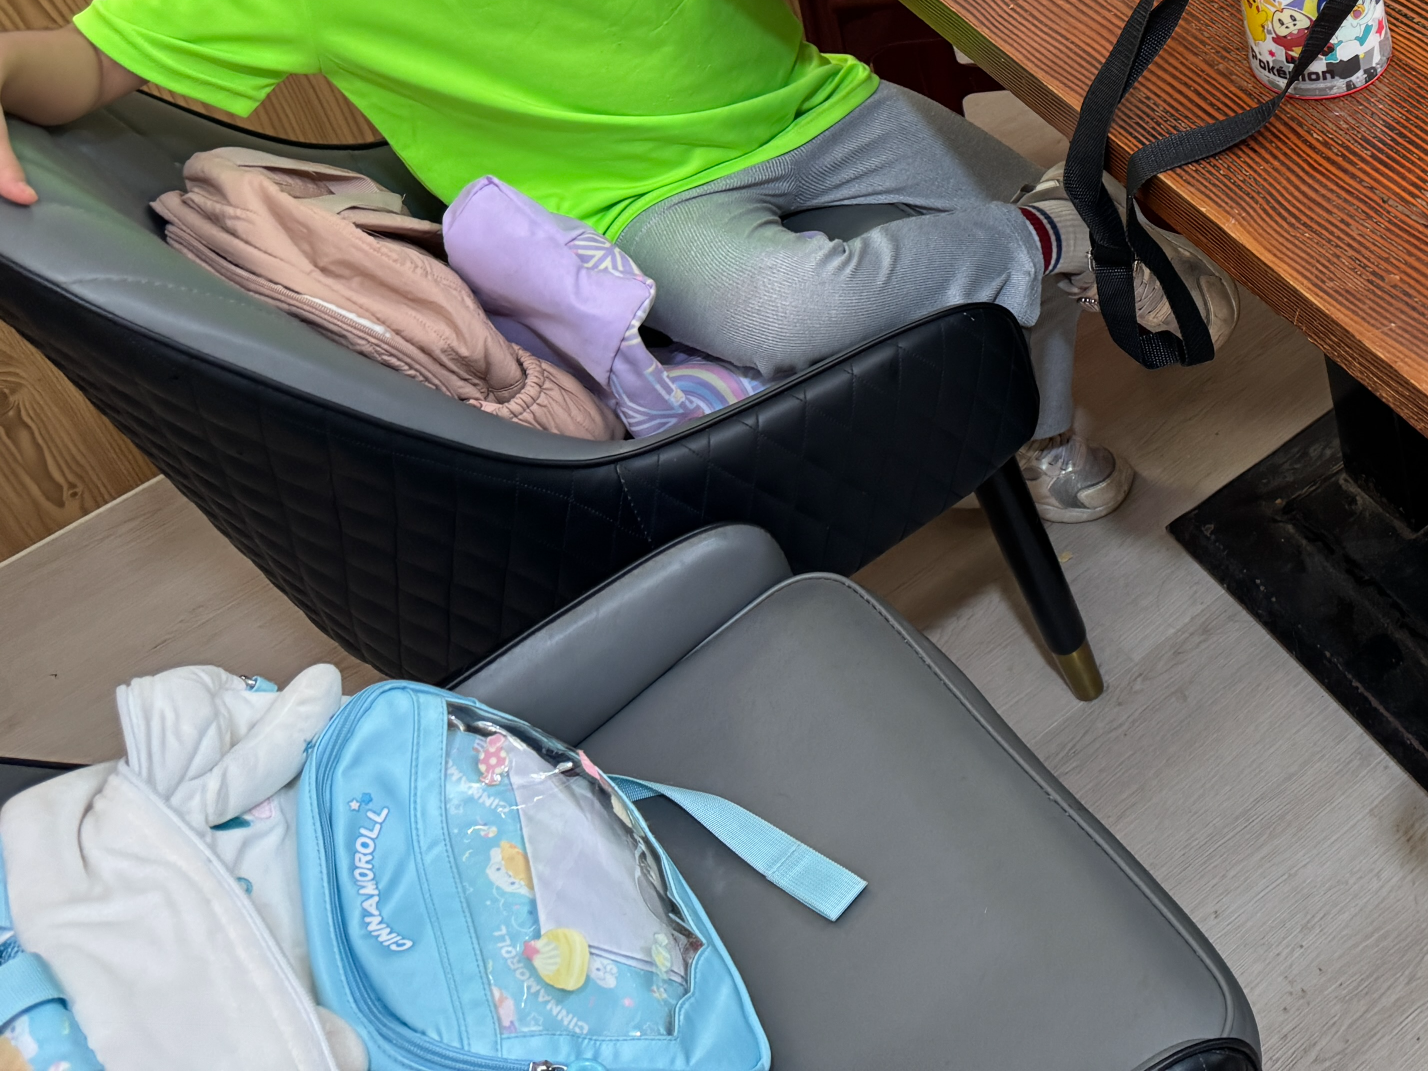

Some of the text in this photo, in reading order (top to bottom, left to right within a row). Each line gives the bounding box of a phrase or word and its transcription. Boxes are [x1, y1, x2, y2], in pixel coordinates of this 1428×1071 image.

[1250, 46, 1335, 82] Pokéon
[353, 807, 413, 952] CINNAMOROLL
[493, 925, 589, 1034] CINNAMOROLL
